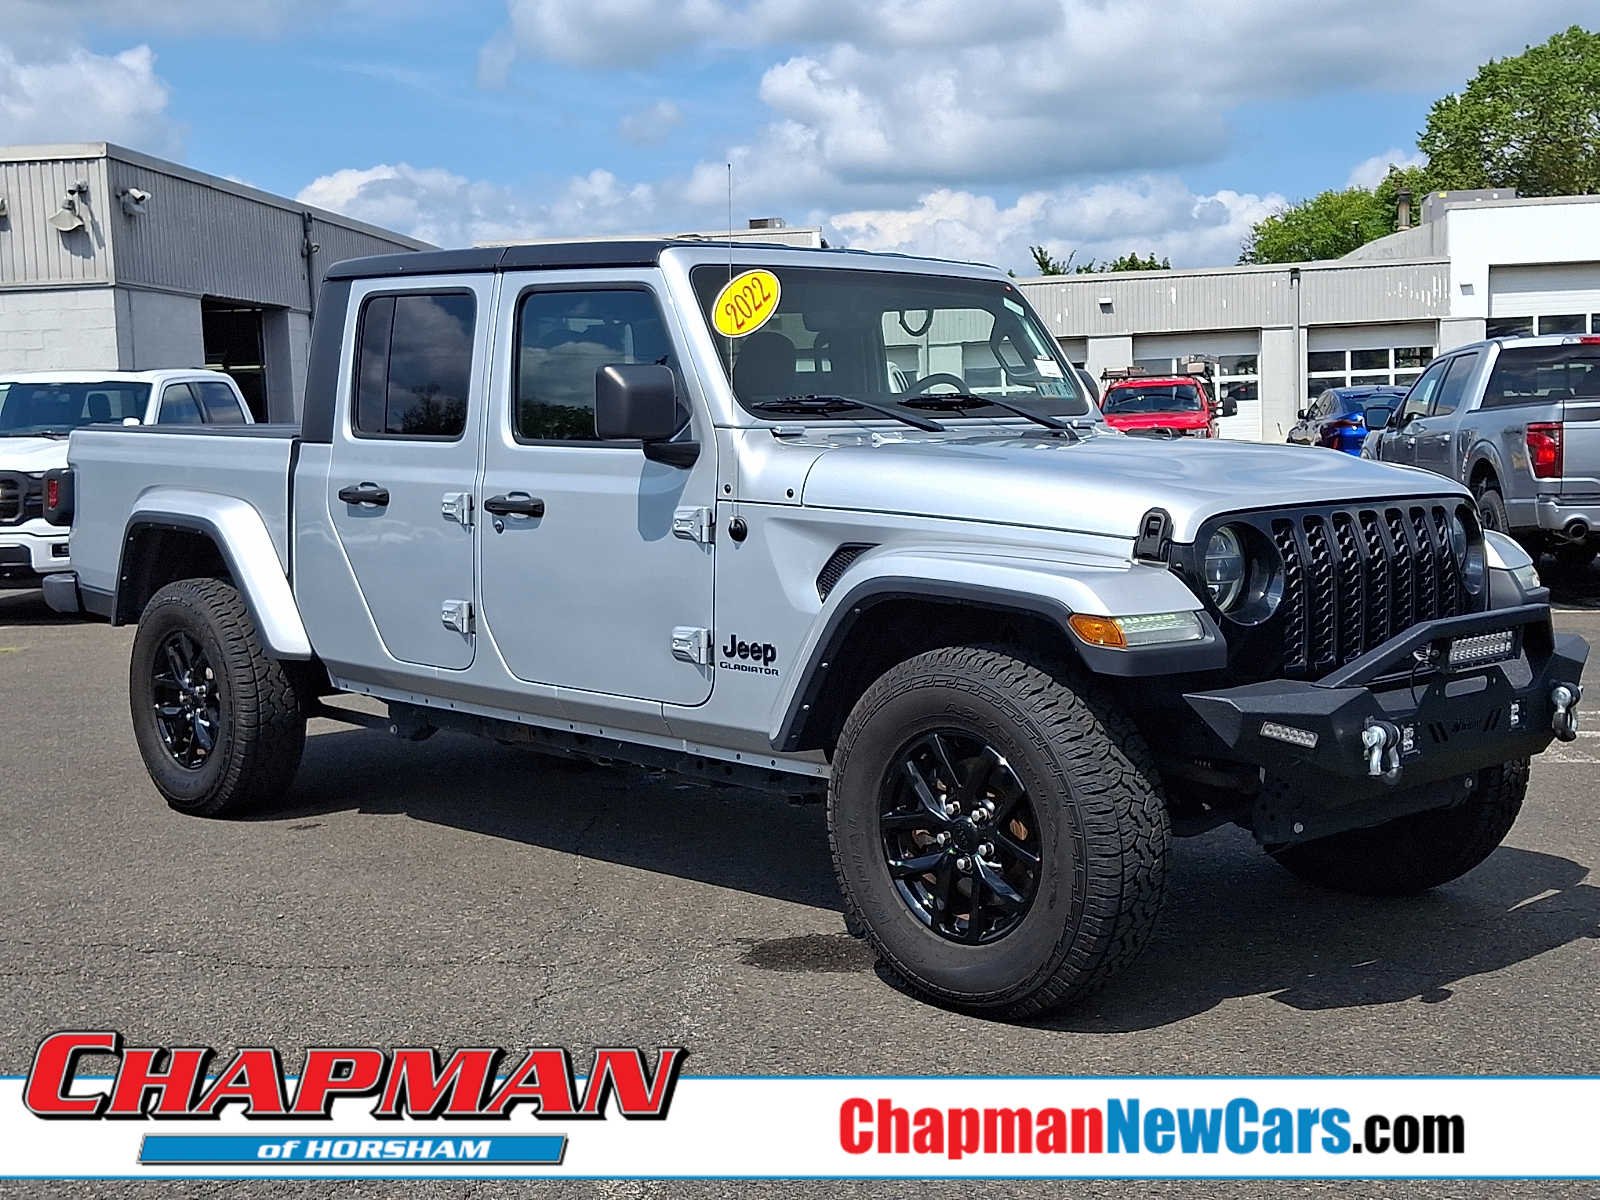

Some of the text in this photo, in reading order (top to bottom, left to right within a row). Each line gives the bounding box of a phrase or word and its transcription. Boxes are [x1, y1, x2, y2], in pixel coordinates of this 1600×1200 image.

[725, 277, 771, 330] 2022
[722, 634, 777, 667] Jeep
[719, 661, 779, 676] GLADIATOR
